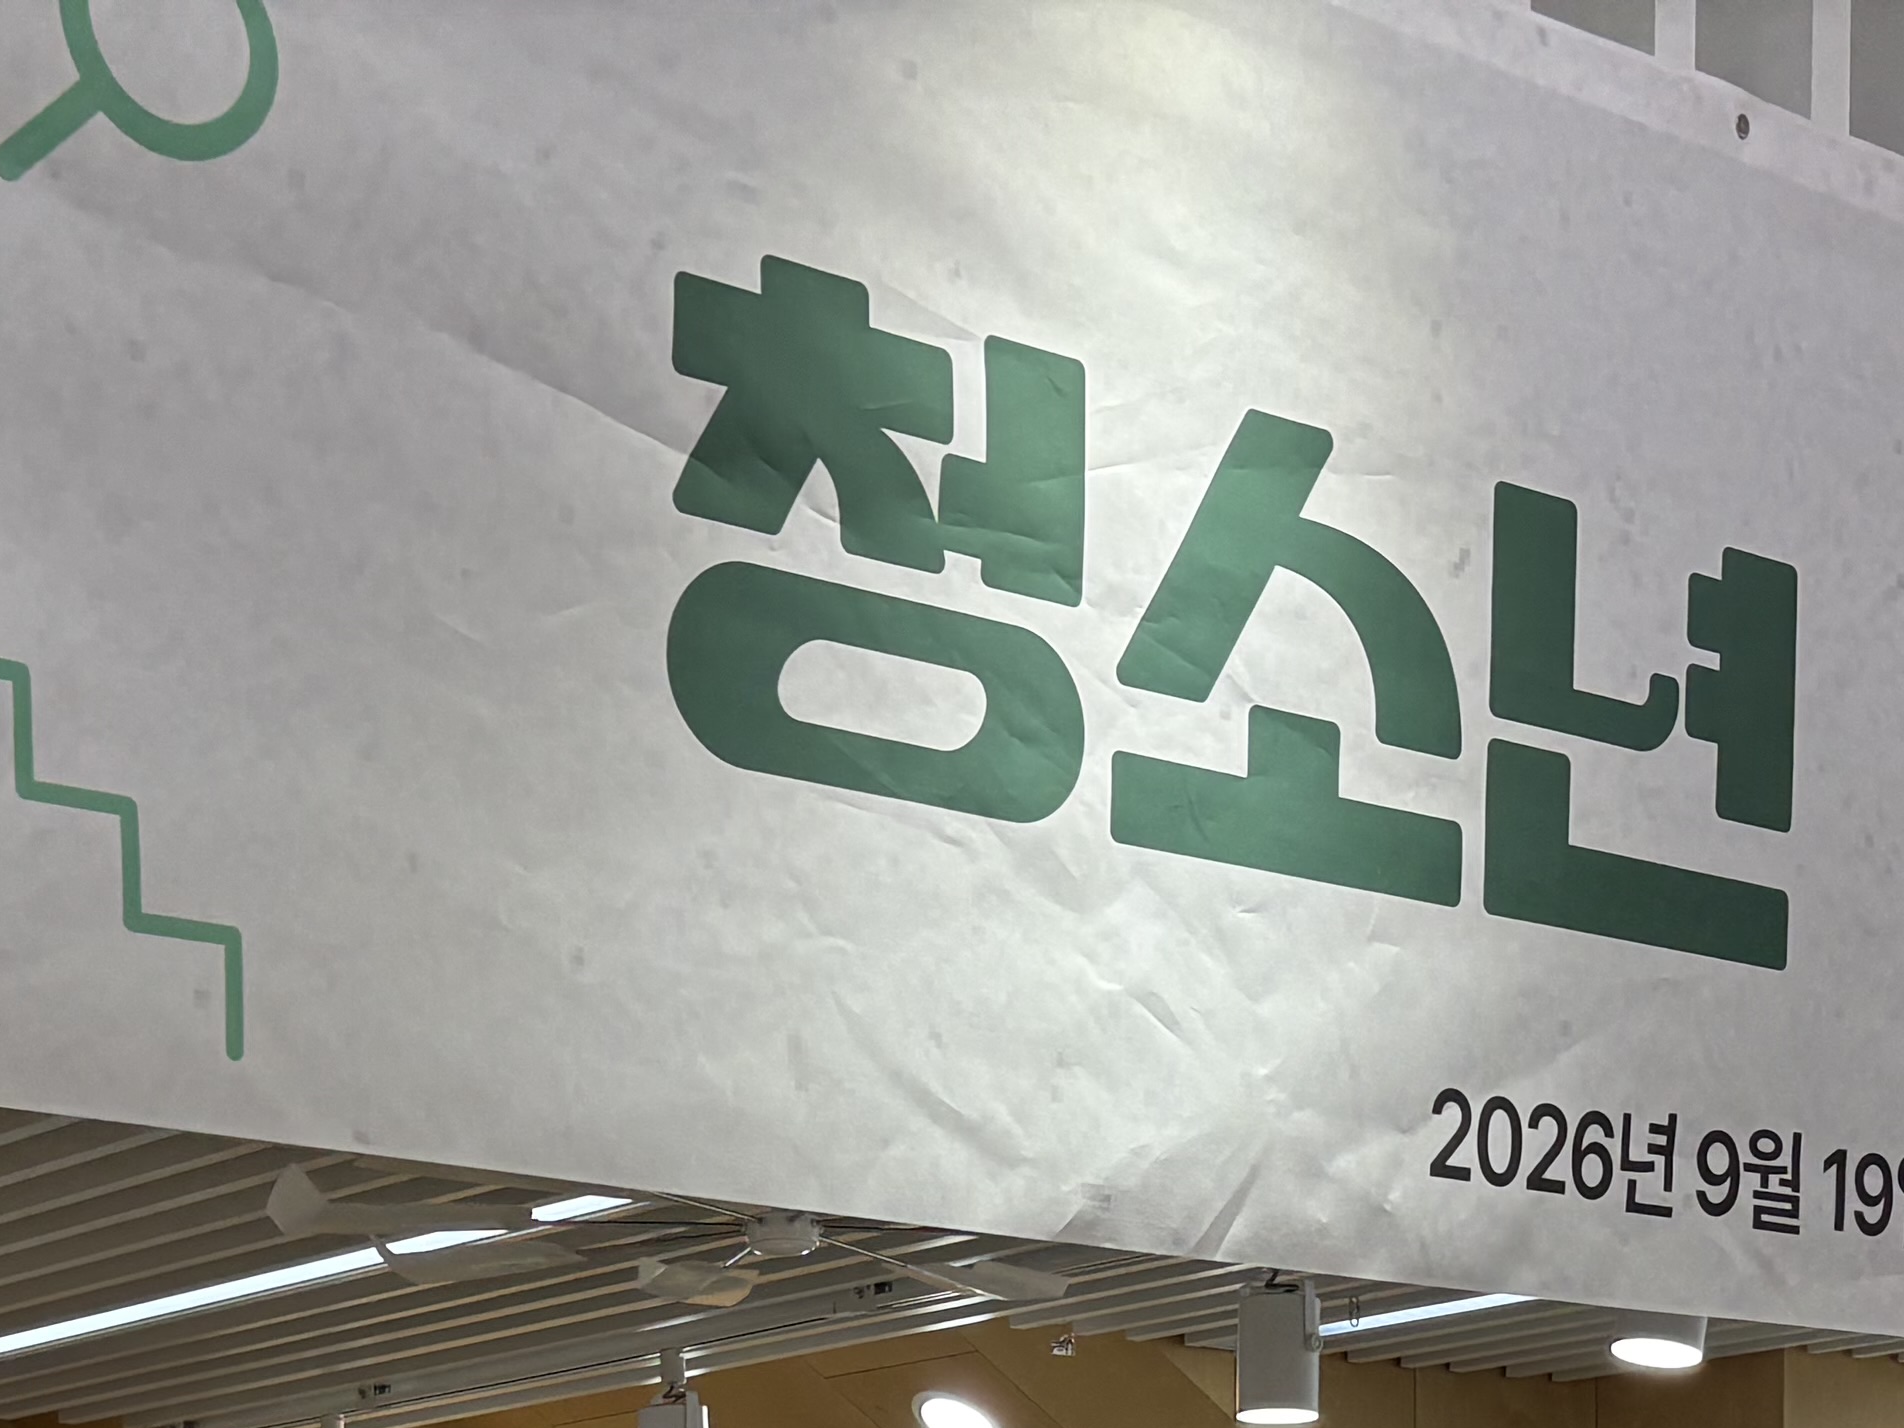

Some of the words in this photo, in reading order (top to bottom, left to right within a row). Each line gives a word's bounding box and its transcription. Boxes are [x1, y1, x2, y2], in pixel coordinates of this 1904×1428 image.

[666, 254, 1798, 971] 청소년
[1428, 1088, 1678, 1219] 2026년
[1694, 1128, 1803, 1236] 9월
